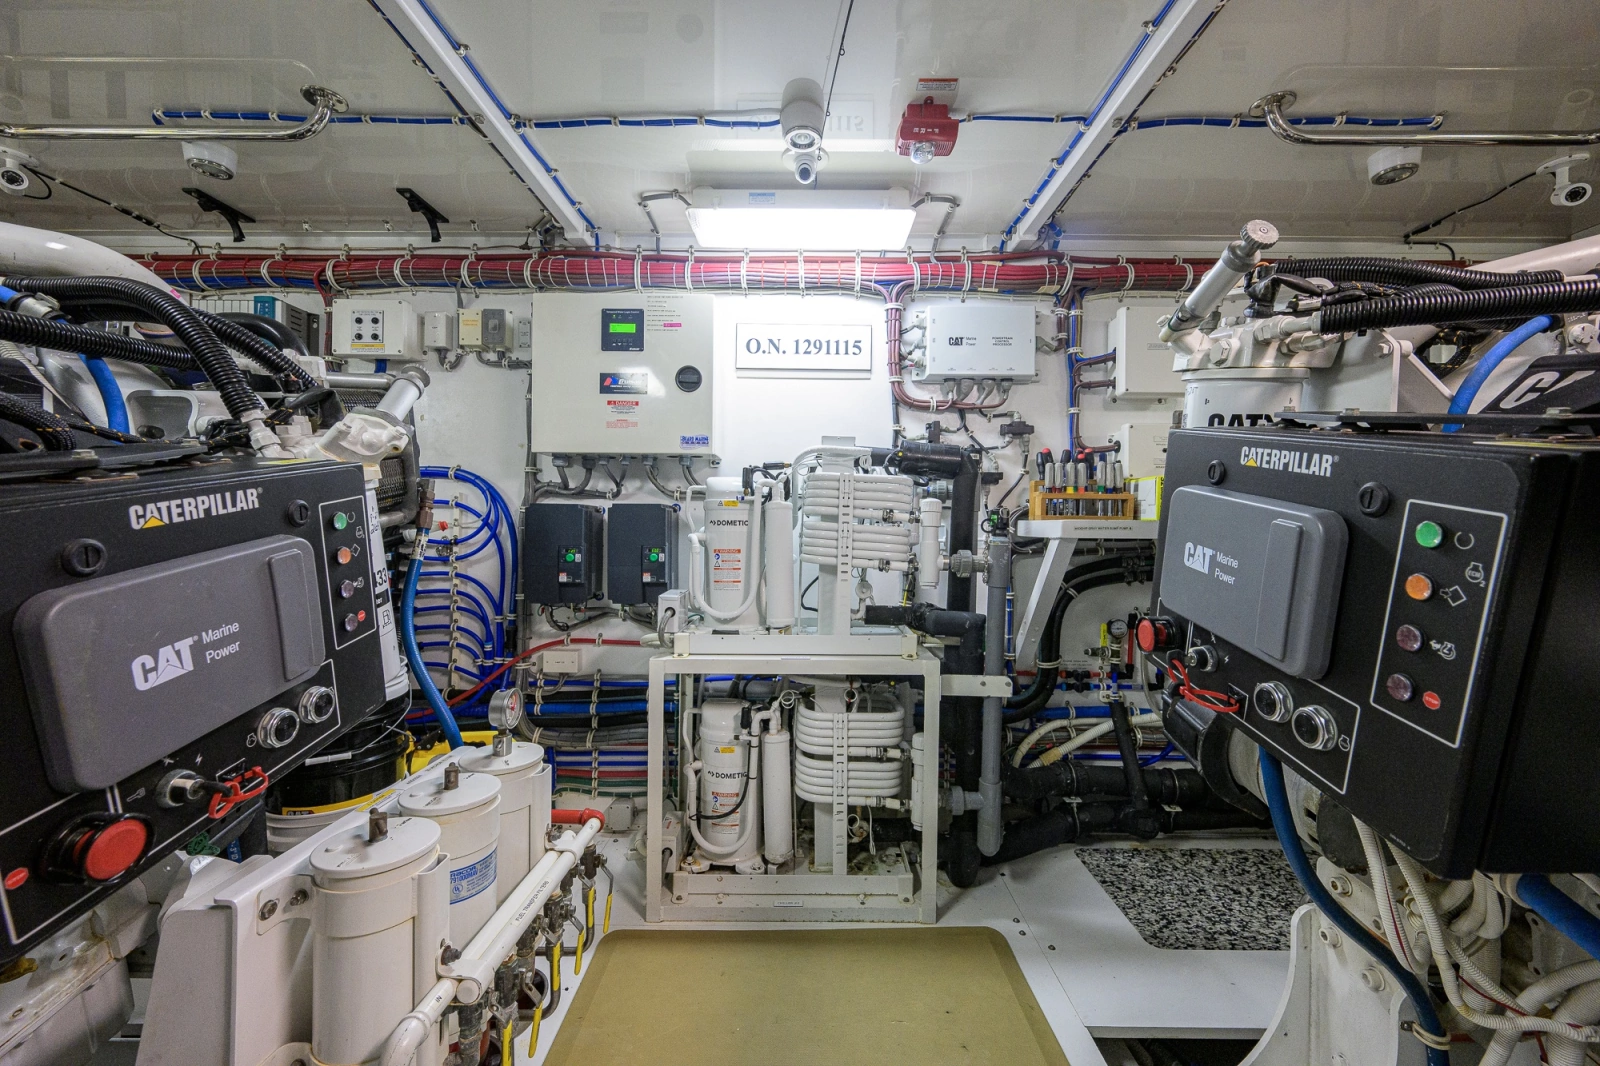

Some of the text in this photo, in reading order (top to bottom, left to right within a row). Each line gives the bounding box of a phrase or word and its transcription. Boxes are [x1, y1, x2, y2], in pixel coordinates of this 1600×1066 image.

[745, 337, 863, 356] O.N. 1291115
[948, 336, 964, 347] CAT
[717, 519, 749, 527] DOMETIC
[1183, 541, 1213, 575] CAT
[1216, 551, 1239, 569] Marine
[1214, 567, 1236, 585] Power
[202, 622, 240, 645] Marine
[205, 641, 240, 664] Power
[131, 636, 194, 691] CAT
[715, 771, 748, 779] DOMETIC
[515, 880, 550, 921] FUEL TRANSFER FILTERS
